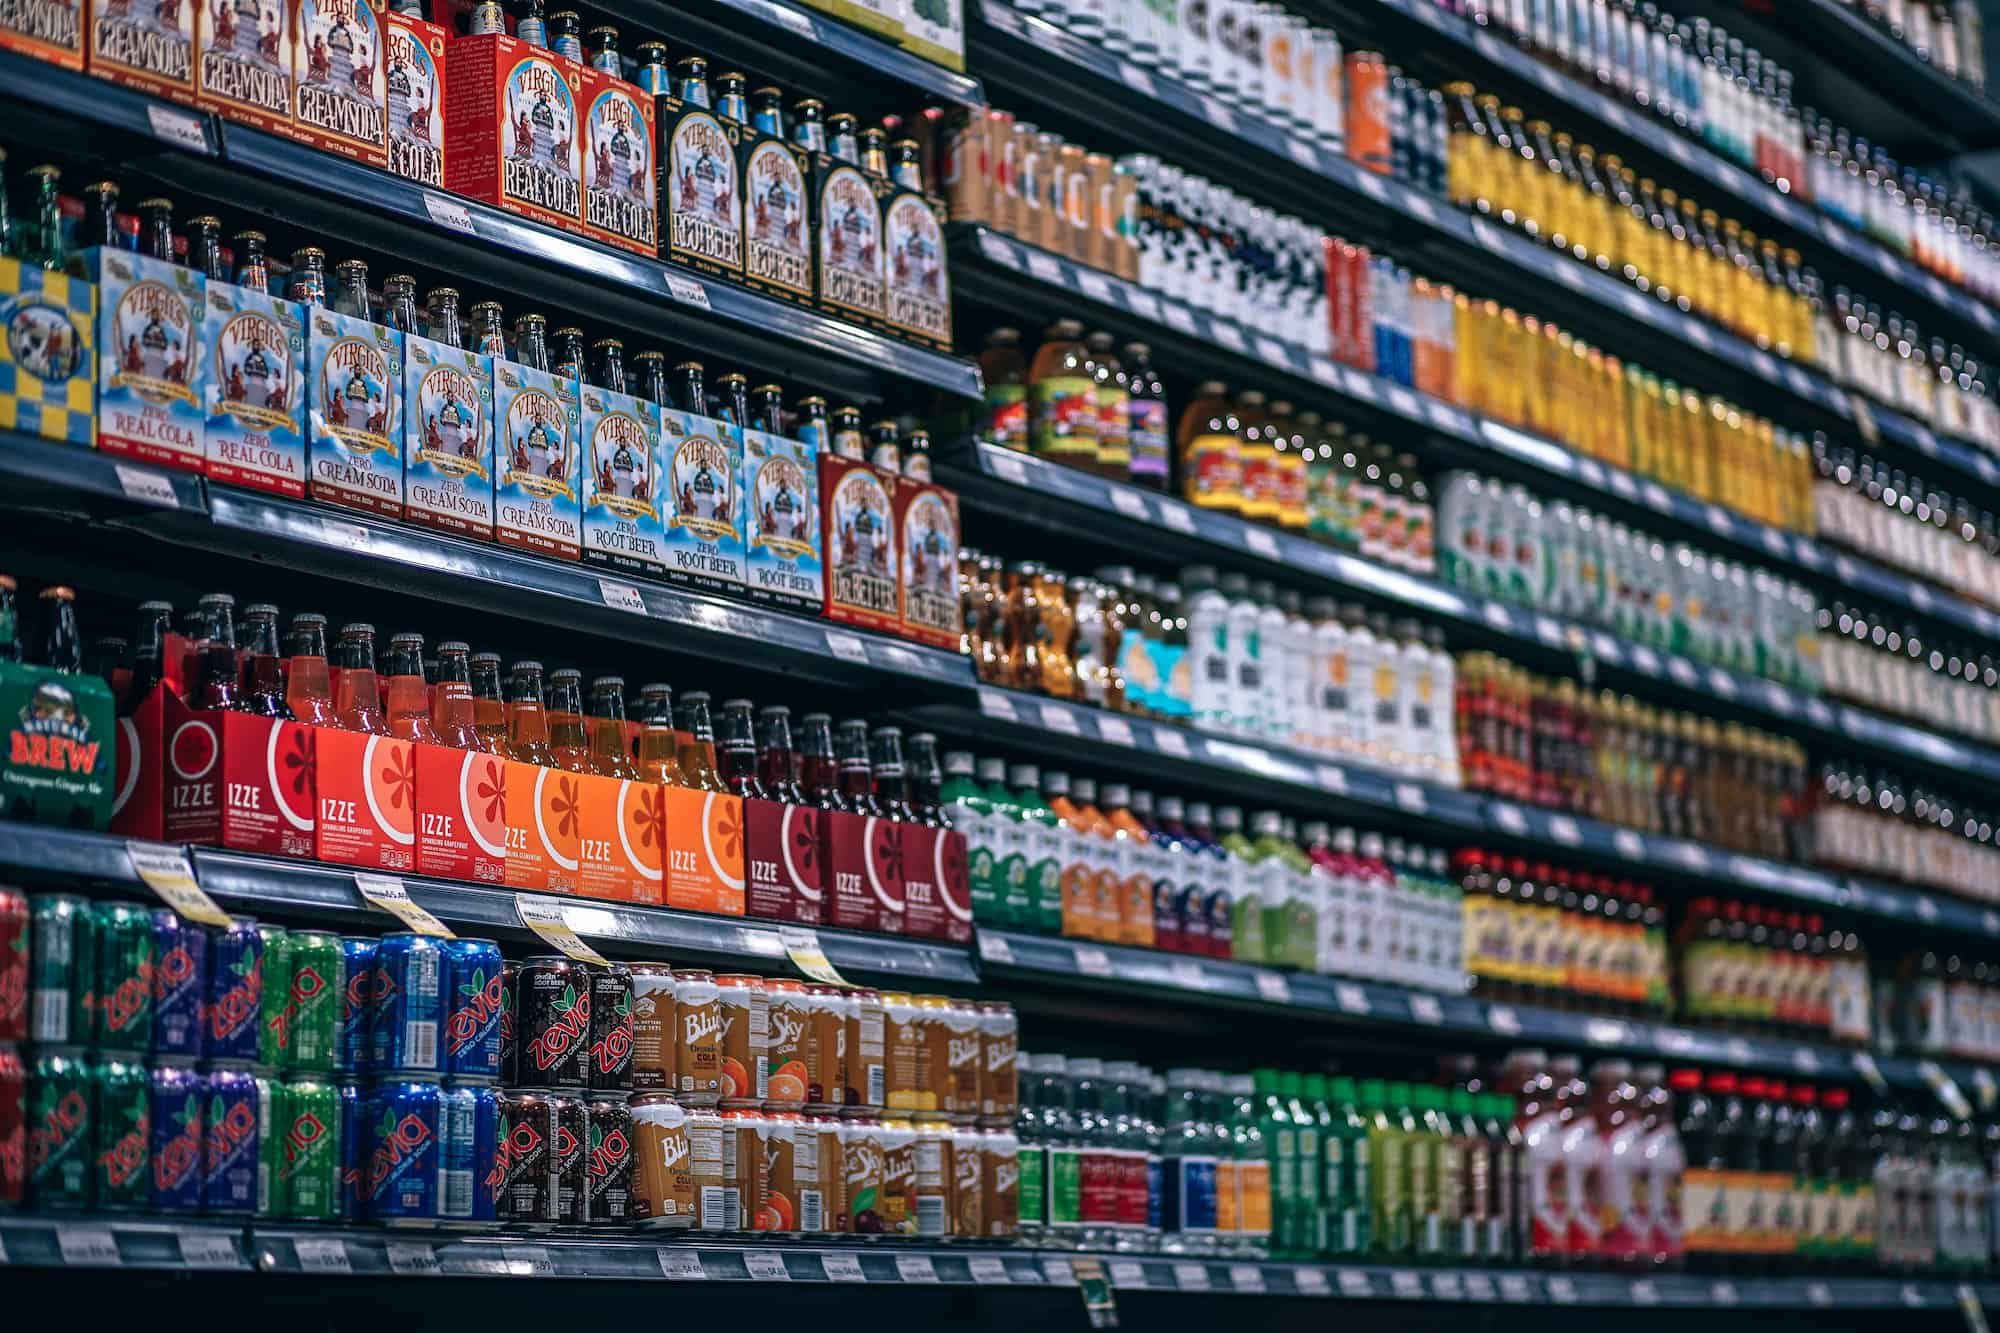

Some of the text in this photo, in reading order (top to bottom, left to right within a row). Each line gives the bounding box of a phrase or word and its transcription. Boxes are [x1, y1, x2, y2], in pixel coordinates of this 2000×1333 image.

[387, 34, 426, 76] RGIL'S
[229, 318, 285, 360] VIRGIL'S
[333, 342, 385, 384] VIRGIL'S
[427, 370, 476, 410] VIRGIL'S
[515, 392, 563, 432] VIRGIL'S
[113, 411, 195, 448] REAL COLA
[243, 431, 271, 450] ZERO
[601, 416, 646, 454] VIRGIL'S
[217, 439, 295, 473] REAL COLA
[348, 455, 373, 471] ZERO
[318, 459, 397, 496] CREAM SODA
[440, 479, 464, 495] ZERO
[413, 485, 488, 519] CREAM SODA
[529, 499, 552, 514] ZERO
[502, 505, 576, 539] CREAM SODA
[616, 520, 638, 535] ZERO
[593, 528, 660, 559] ROOT BEER
[696, 542, 719, 556] ZERO
[674, 550, 741, 580] ROOT BEER
[173, 783, 215, 809] IZZE
[228, 783, 261, 809] IZZE
[321, 798, 357, 824] IZZE
[421, 813, 453, 838] IZZE
[505, 827, 528, 849] ZZE
[580, 839, 611, 863] IZZE
[671, 847, 697, 872] IZZE
[751, 859, 779, 883] IZZE
[836, 871, 863, 895] IZZE
[684, 1011, 721, 1046] Blu
[661, 1133, 690, 1168] Blu
